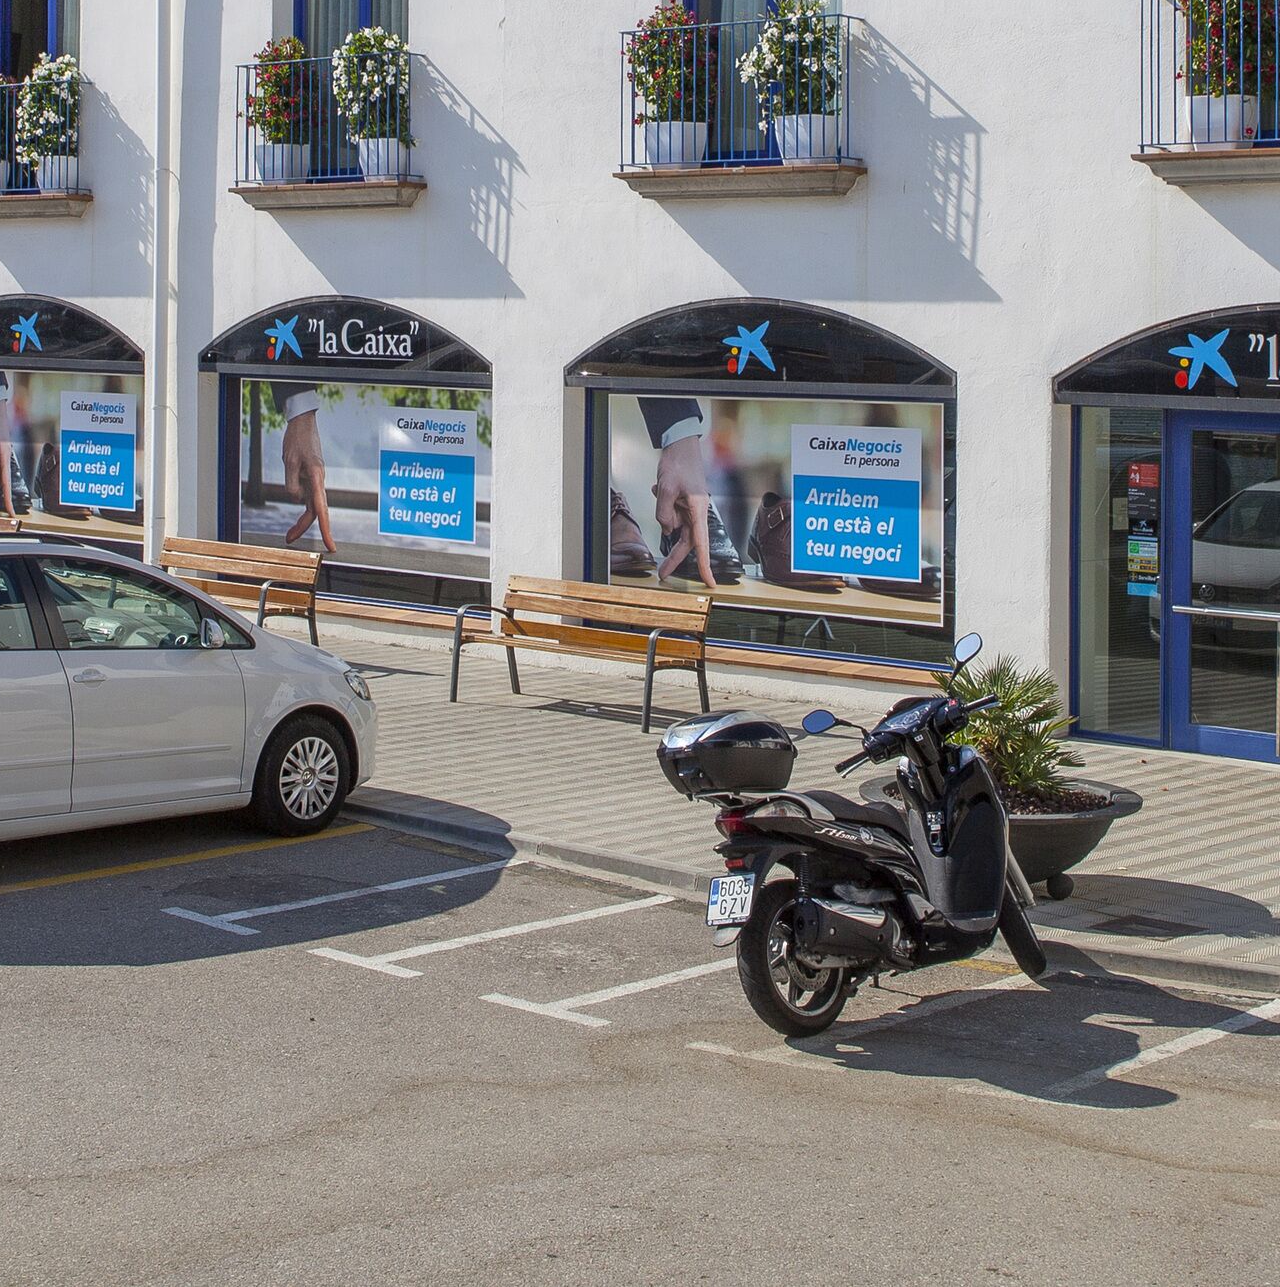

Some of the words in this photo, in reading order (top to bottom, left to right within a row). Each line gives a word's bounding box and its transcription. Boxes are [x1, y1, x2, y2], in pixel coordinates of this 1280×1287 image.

[70, 401, 125, 415] CaixaNegocis
[91, 414, 99, 423] En
[99, 415, 124, 424] persona
[397, 417, 467, 435] CaixaNegocis
[68, 440, 112, 456] Arribem
[422, 433, 433, 443] En
[433, 434, 465, 446] persona
[809, 437, 903, 455] CaixaNegocis
[68, 462, 81, 473] on
[84, 461, 107, 475] està
[109, 462, 121, 476] el
[844, 454, 857, 465] En
[858, 456, 900, 468] persona
[389, 462, 445, 480] Arribem
[68, 479, 86, 493] teu
[88, 482, 125, 499] negoci
[389, 487, 407, 500] on
[410, 485, 438, 503] està
[442, 487, 456, 504] el
[805, 488, 880, 509] Arribem
[389, 506, 411, 522] teu
[414, 509, 462, 528] negoci
[805, 517, 829, 532] on
[834, 515, 871, 535] està
[876, 517, 895, 536] el
[806, 539, 835, 558] teu
[840, 544, 902, 565] negoci
[720, 878, 751, 897] 6035
[720, 897, 748, 916] GZV
